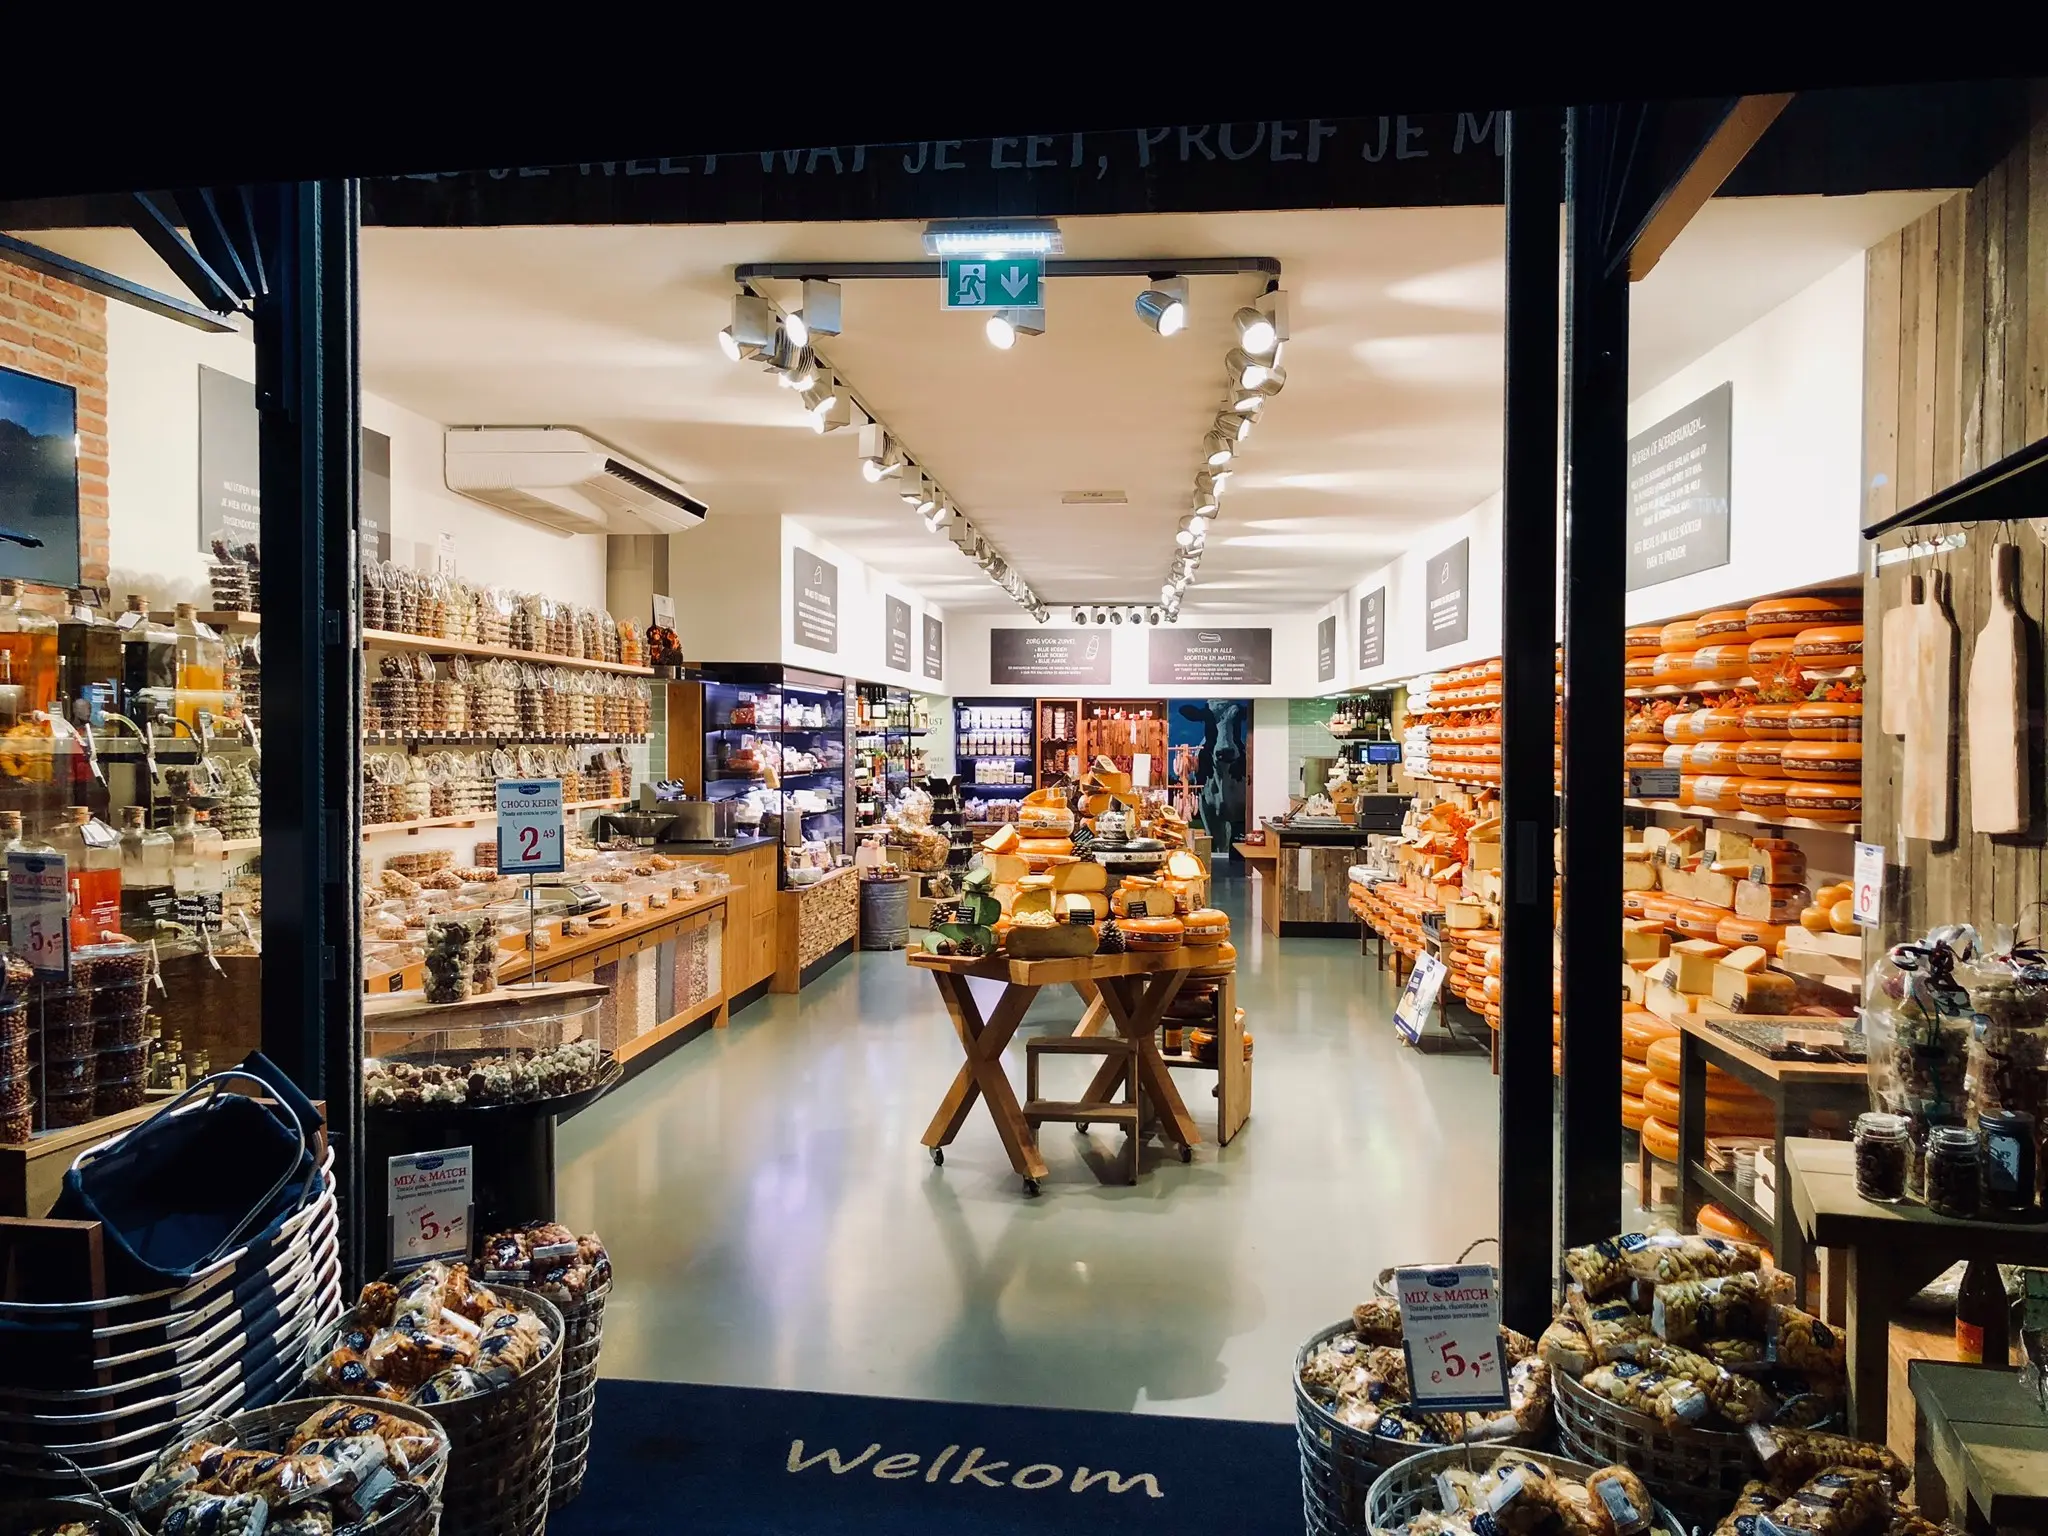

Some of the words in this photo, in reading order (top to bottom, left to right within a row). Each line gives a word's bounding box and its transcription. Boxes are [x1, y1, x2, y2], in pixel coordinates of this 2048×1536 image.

[1136, 119, 1337, 168] PROEF
[1361, 114, 1429, 163] JE
[501, 800, 530, 809] CHOCO
[532, 799, 558, 808] KEIEN
[394, 1174, 416, 1187] MIX
[418, 1174, 426, 1183] &
[428, 1167, 467, 1181] MATCH
[1404, 1290, 1430, 1304] MIX
[1432, 1291, 1442, 1302] &
[1443, 1288, 1489, 1301] MATCH
[785, 1439, 1164, 1499] Welkom
